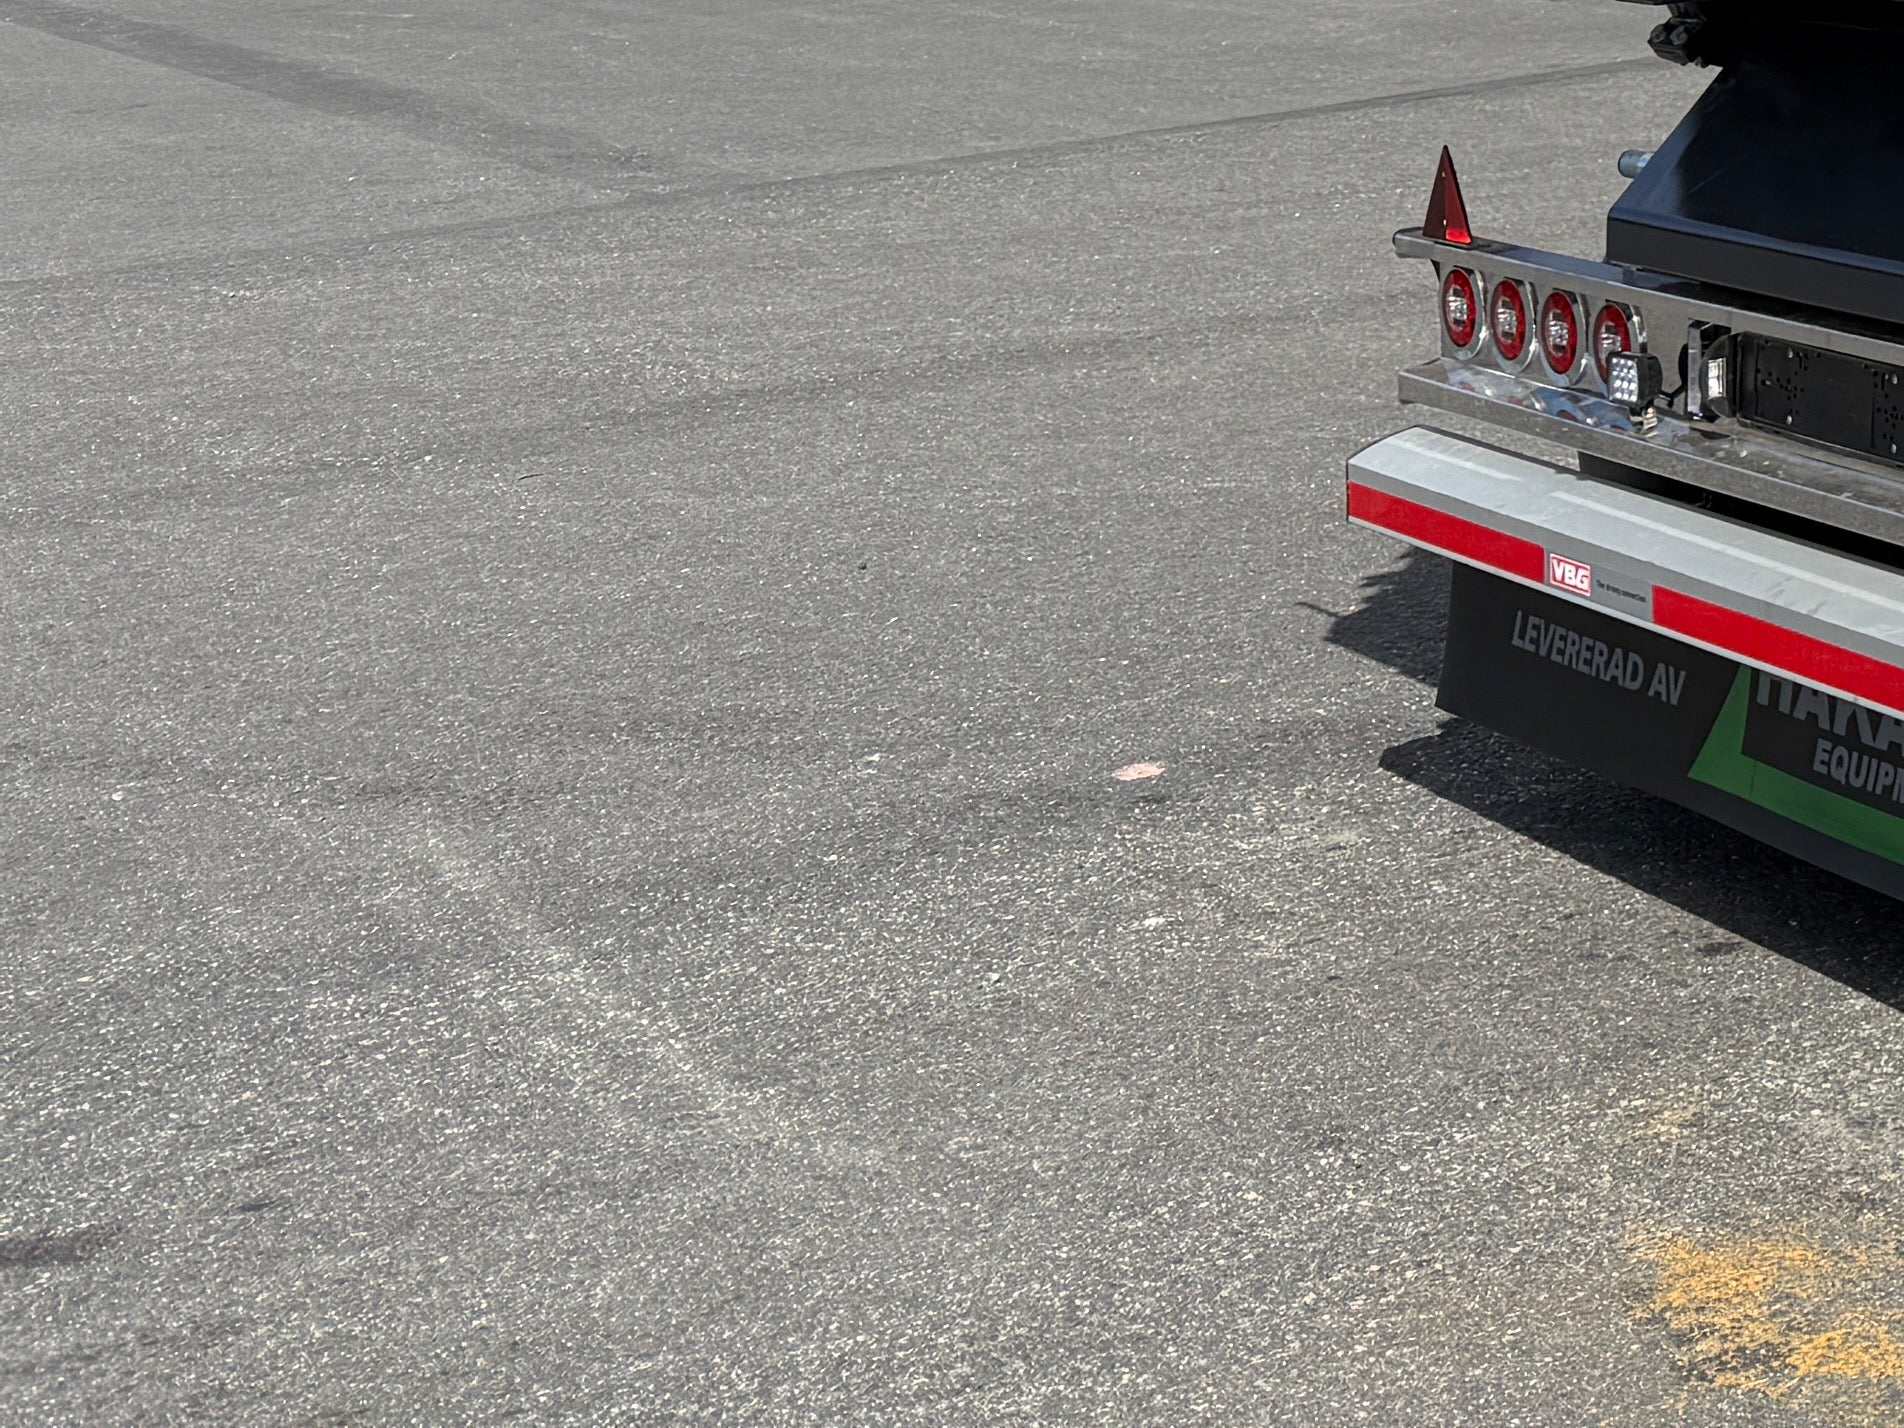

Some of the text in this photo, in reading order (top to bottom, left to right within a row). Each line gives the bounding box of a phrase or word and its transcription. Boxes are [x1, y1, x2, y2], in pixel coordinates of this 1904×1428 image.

[1551, 558, 1590, 591] VBG
[1511, 609, 1687, 706] LEVERERAD AV
